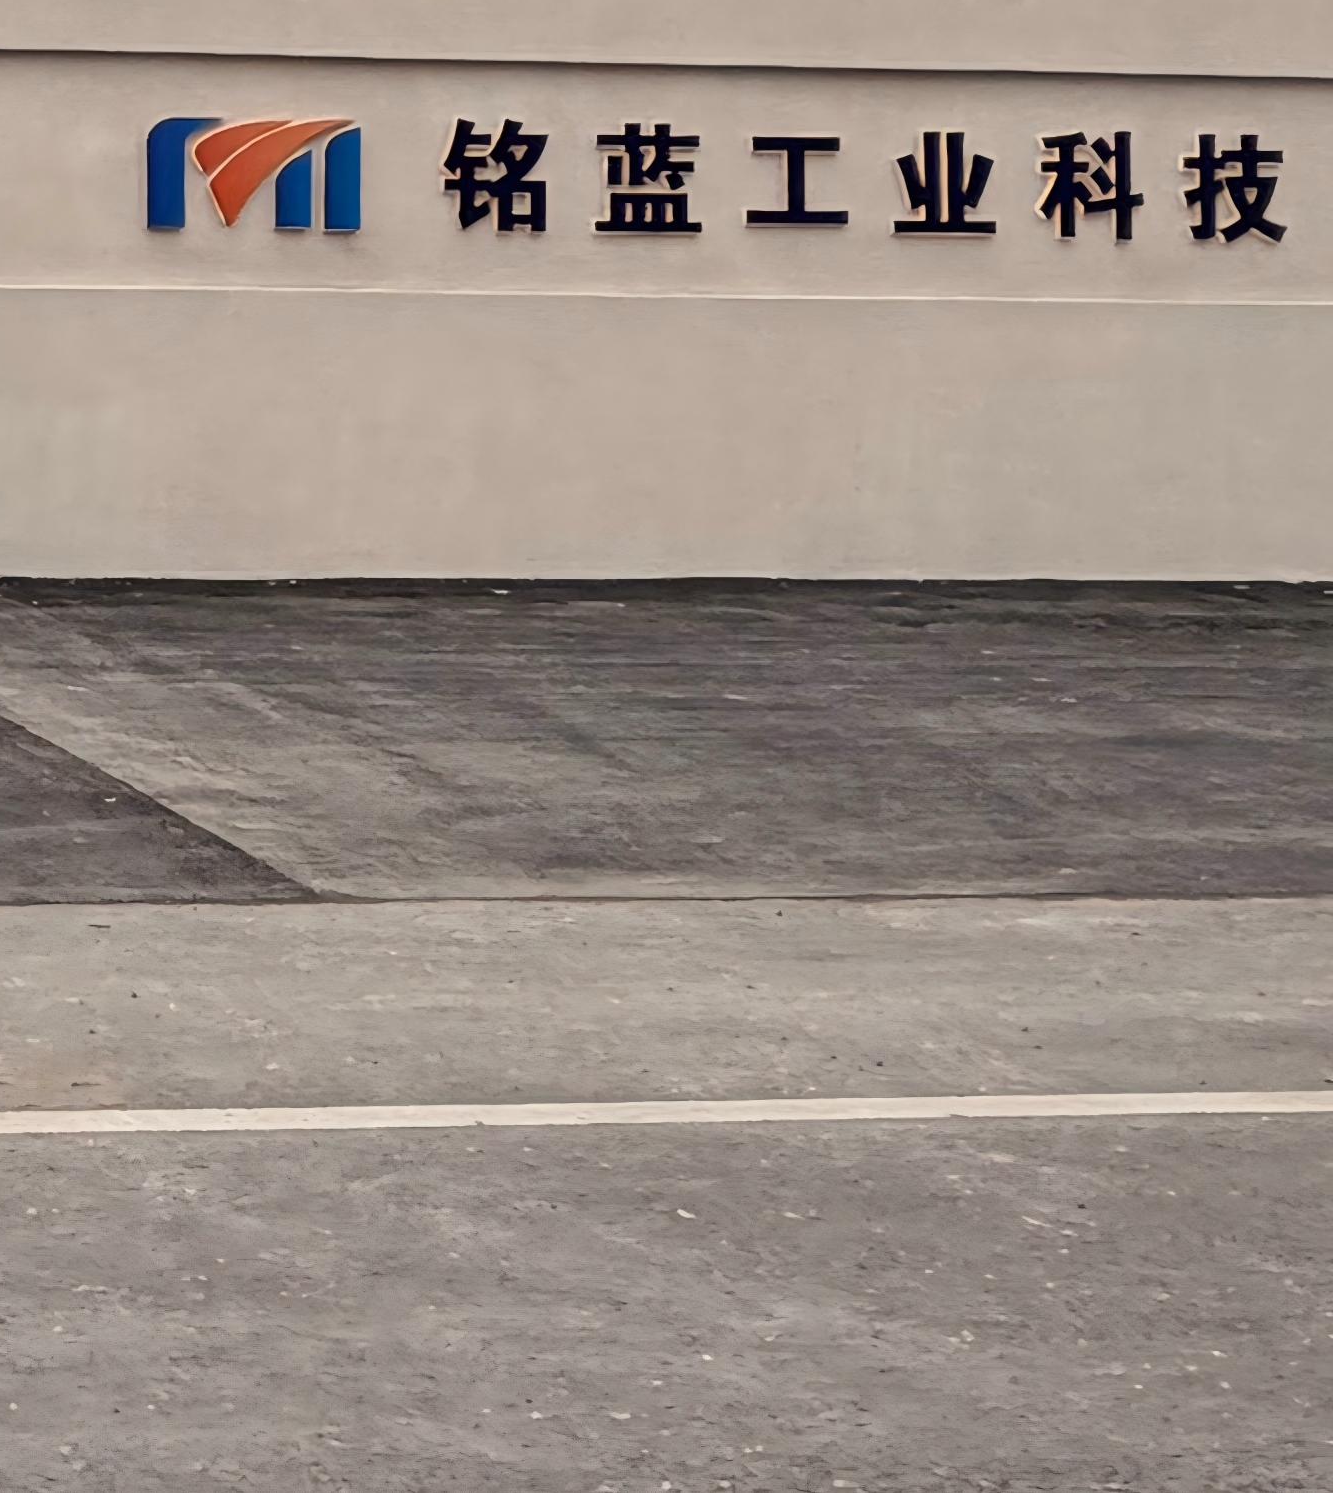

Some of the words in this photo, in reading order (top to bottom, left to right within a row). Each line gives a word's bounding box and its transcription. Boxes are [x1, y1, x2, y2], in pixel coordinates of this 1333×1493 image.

[440, 116, 1290, 245] 铭蓝工业科技
